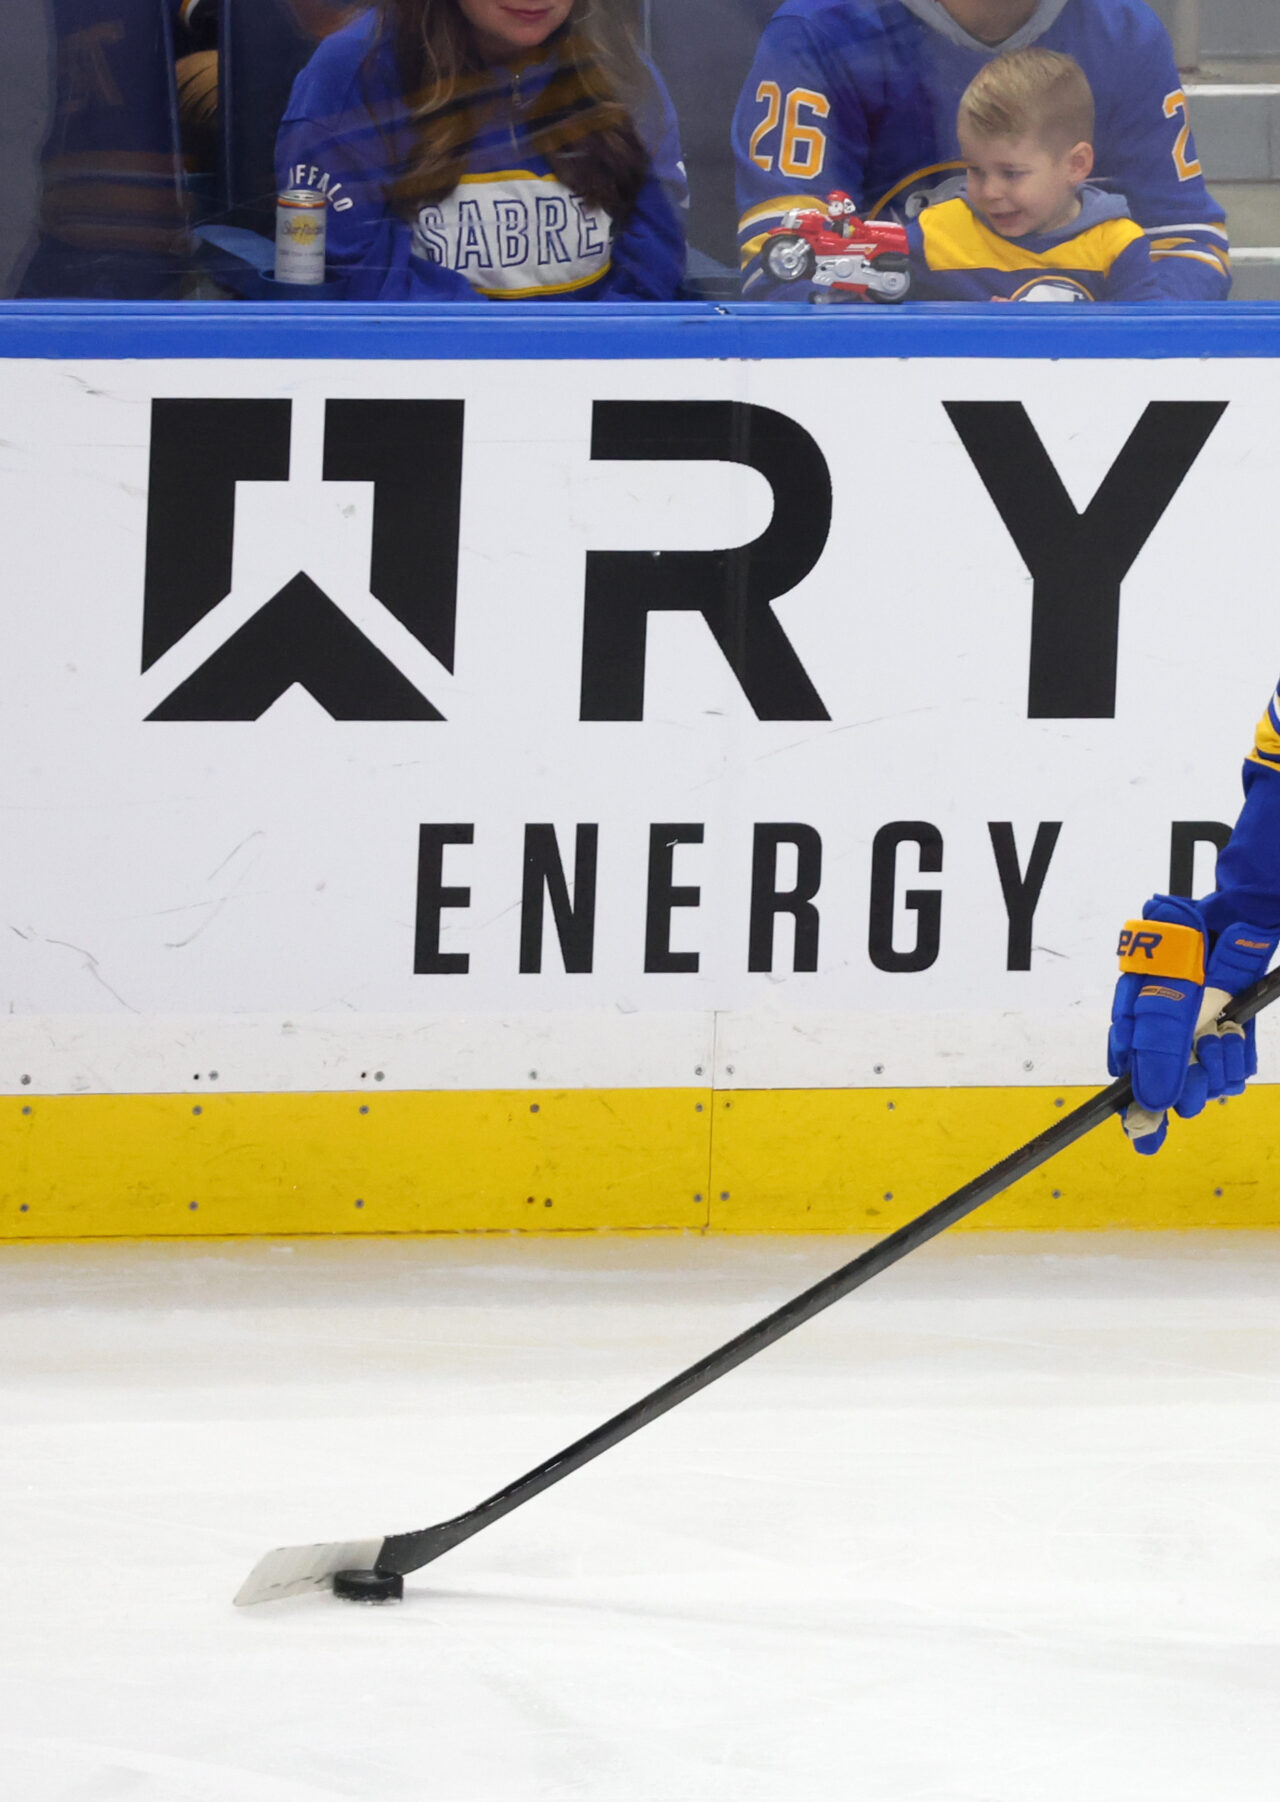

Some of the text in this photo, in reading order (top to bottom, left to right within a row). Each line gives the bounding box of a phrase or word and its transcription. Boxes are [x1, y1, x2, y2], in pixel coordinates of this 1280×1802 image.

[749, 81, 831, 180] 26
[417, 195, 613, 271] SABRE
[413, 820, 1063, 975] ENERGY
